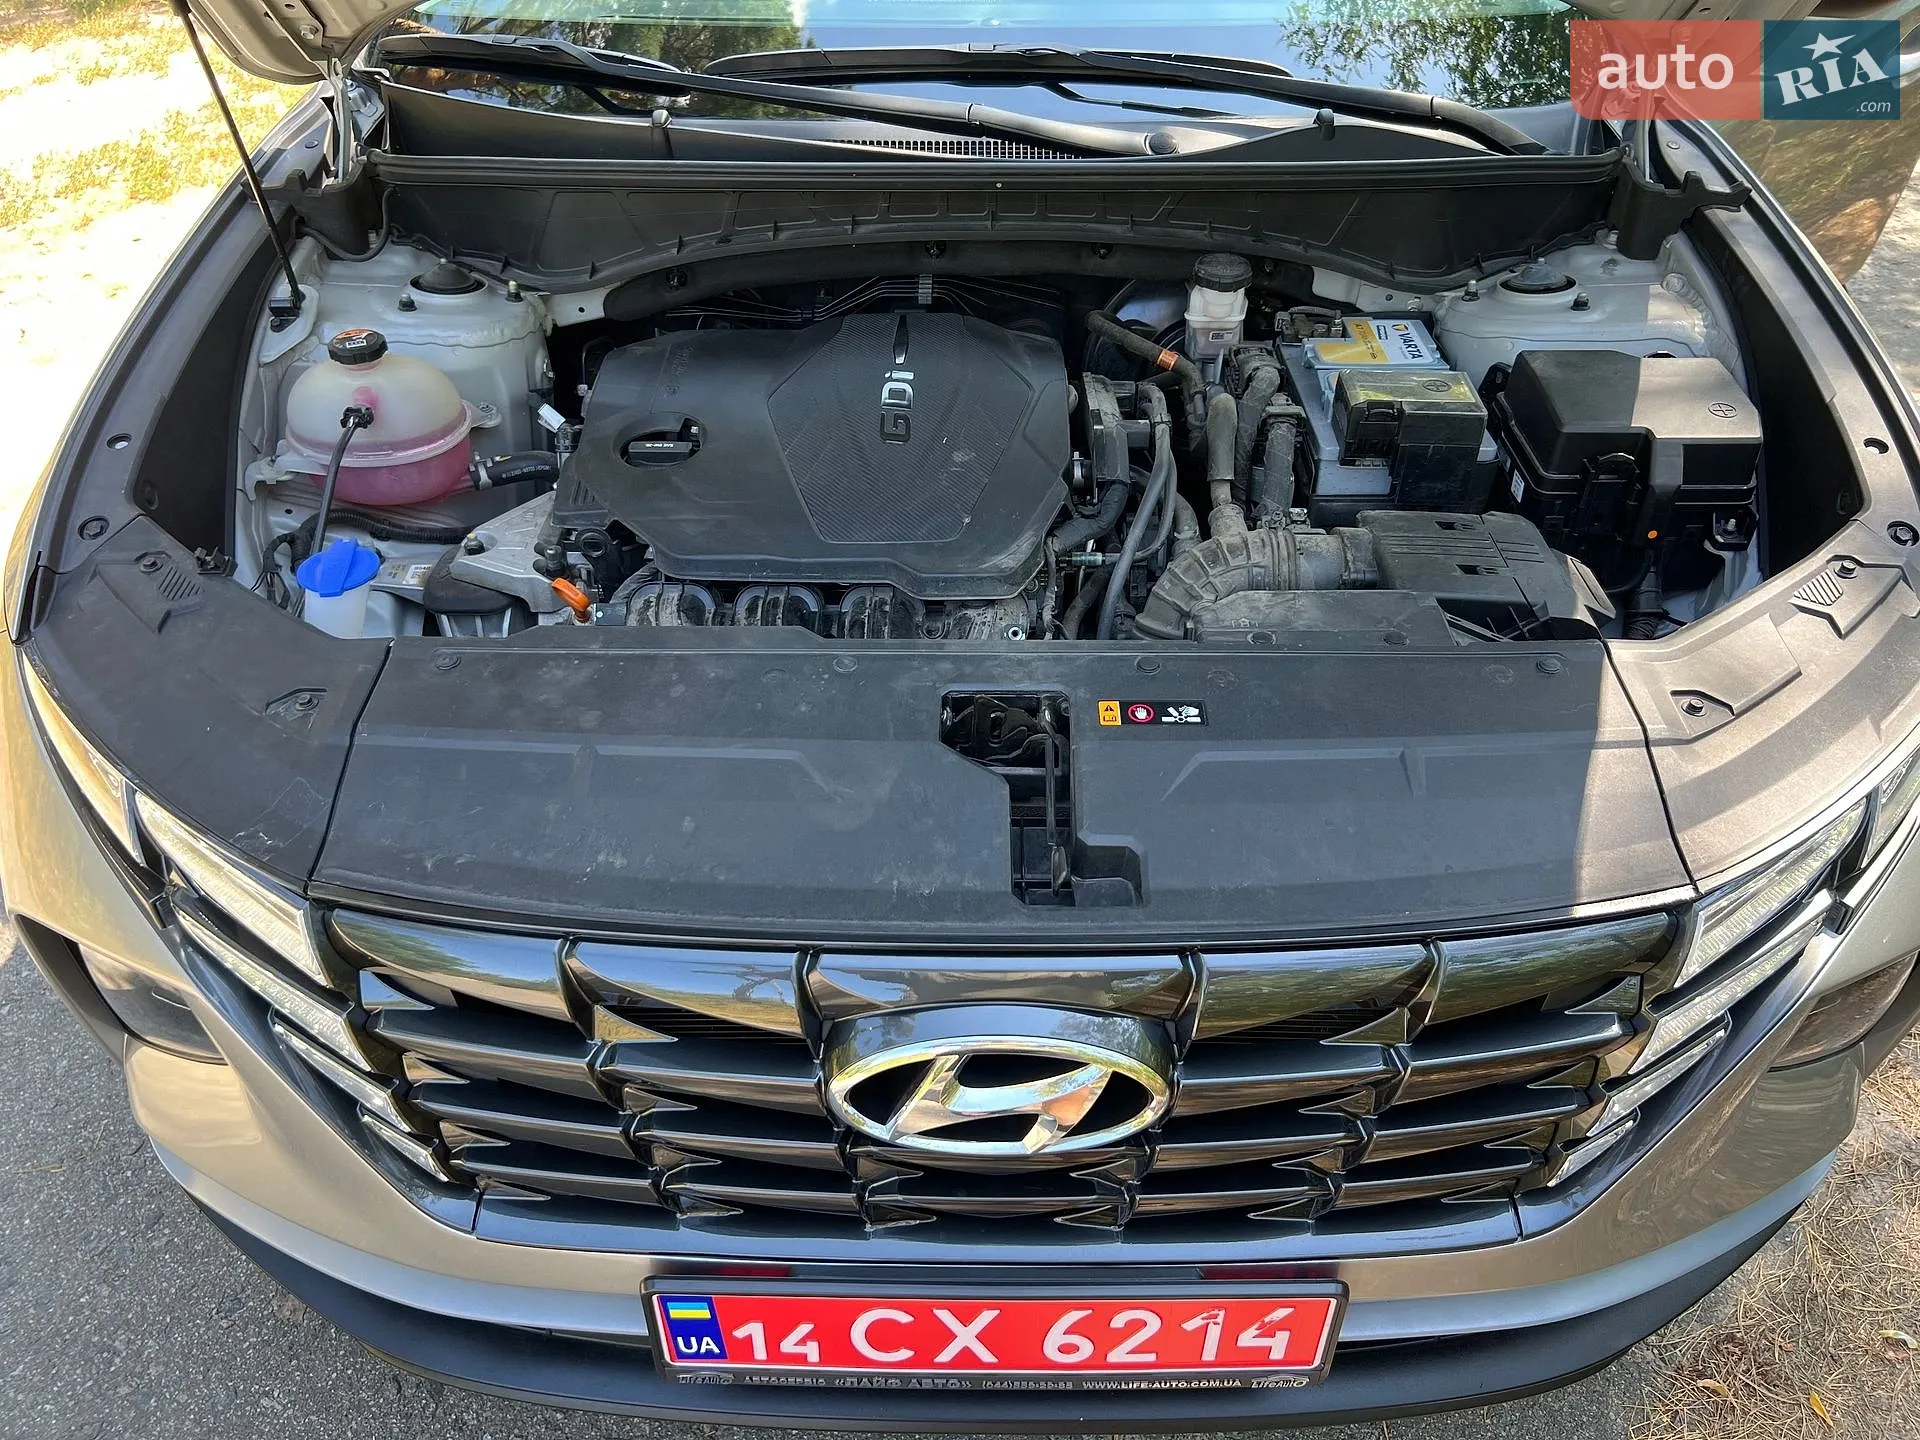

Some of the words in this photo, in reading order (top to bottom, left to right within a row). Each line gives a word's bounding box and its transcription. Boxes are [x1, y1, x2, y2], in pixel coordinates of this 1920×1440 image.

[1398, 332, 1424, 360] VARTA
[880, 370, 915, 444] GDi
[676, 1336, 721, 1354] UA
[732, 1321, 821, 1363] 14
[849, 1307, 1001, 1364] CX
[1042, 1306, 1296, 1364] 6214
